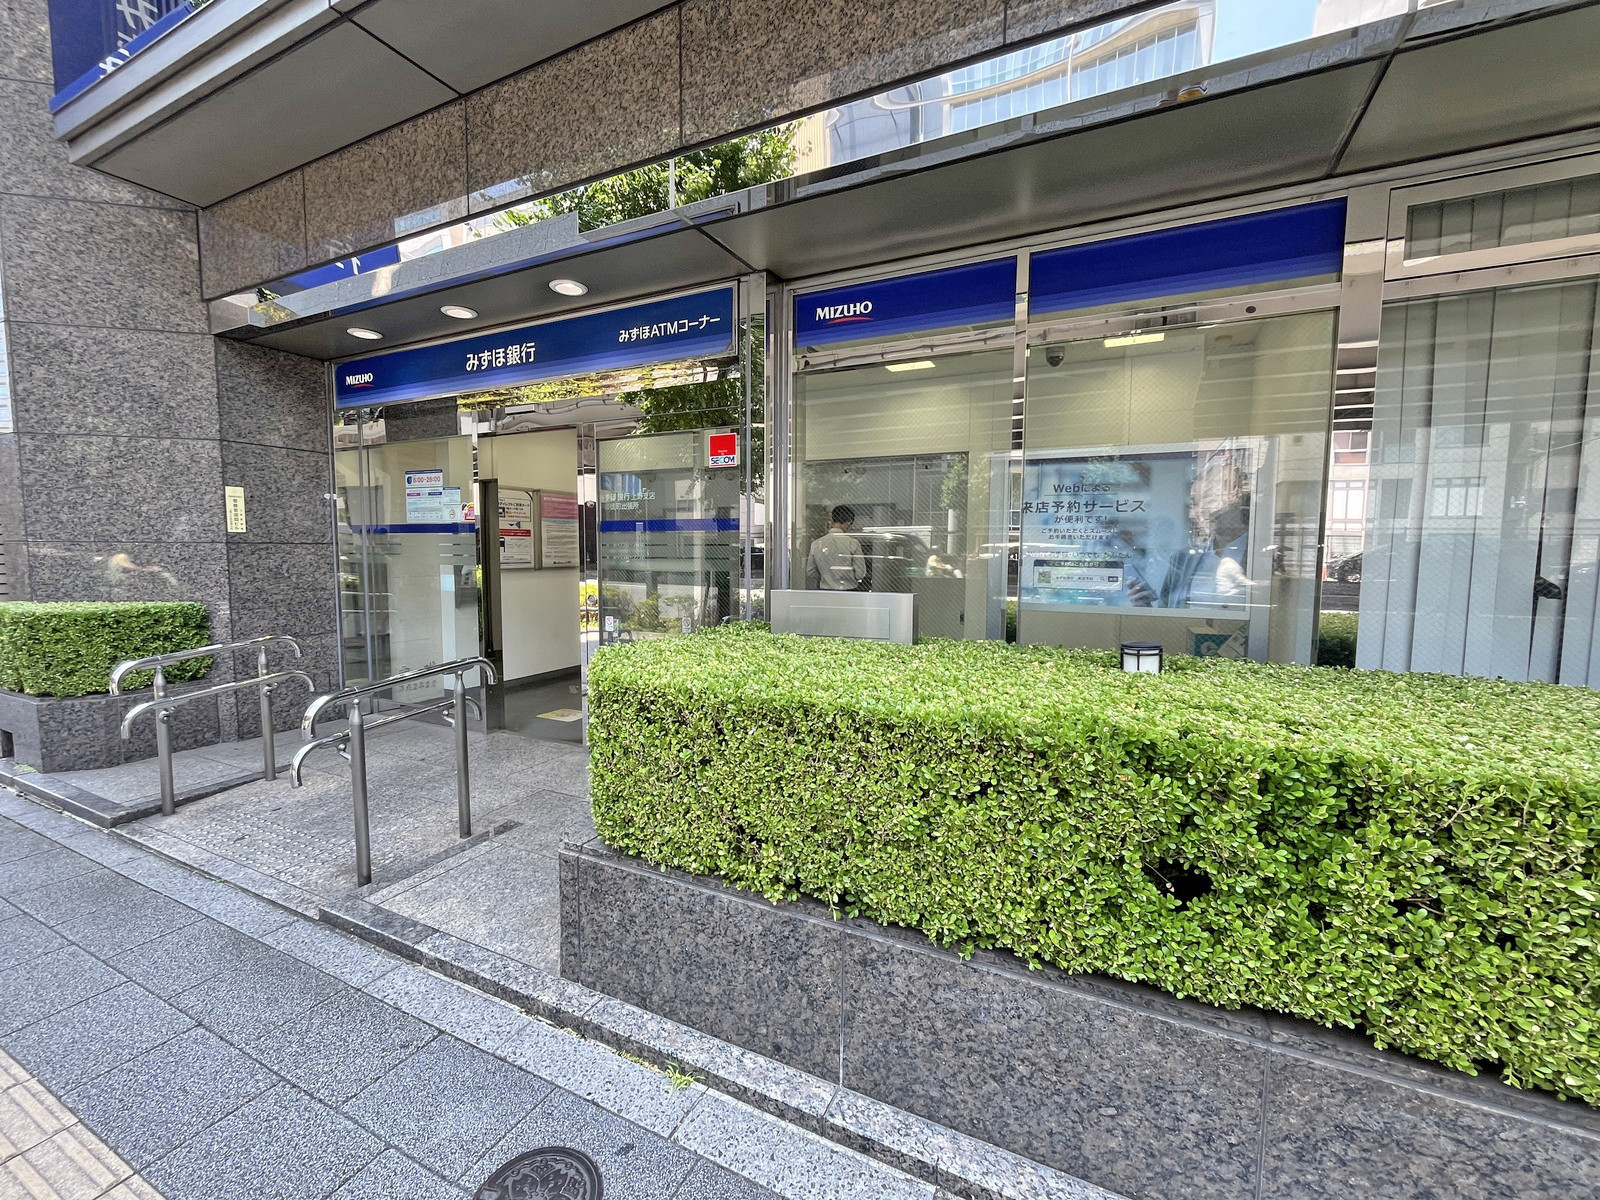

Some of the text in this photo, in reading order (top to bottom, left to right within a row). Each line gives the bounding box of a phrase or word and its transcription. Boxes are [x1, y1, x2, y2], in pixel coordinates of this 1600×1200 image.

[815, 301, 873, 321] MIZUHO
[618, 314, 721, 343] みずほATMコーナー
[465, 342, 536, 372] みずほ銀行
[345, 372, 374, 386] MIZUHO
[711, 456, 735, 465] SECOM
[1053, 484, 1111, 493] Webによる
[1022, 499, 1146, 514] 来店予約サービス
